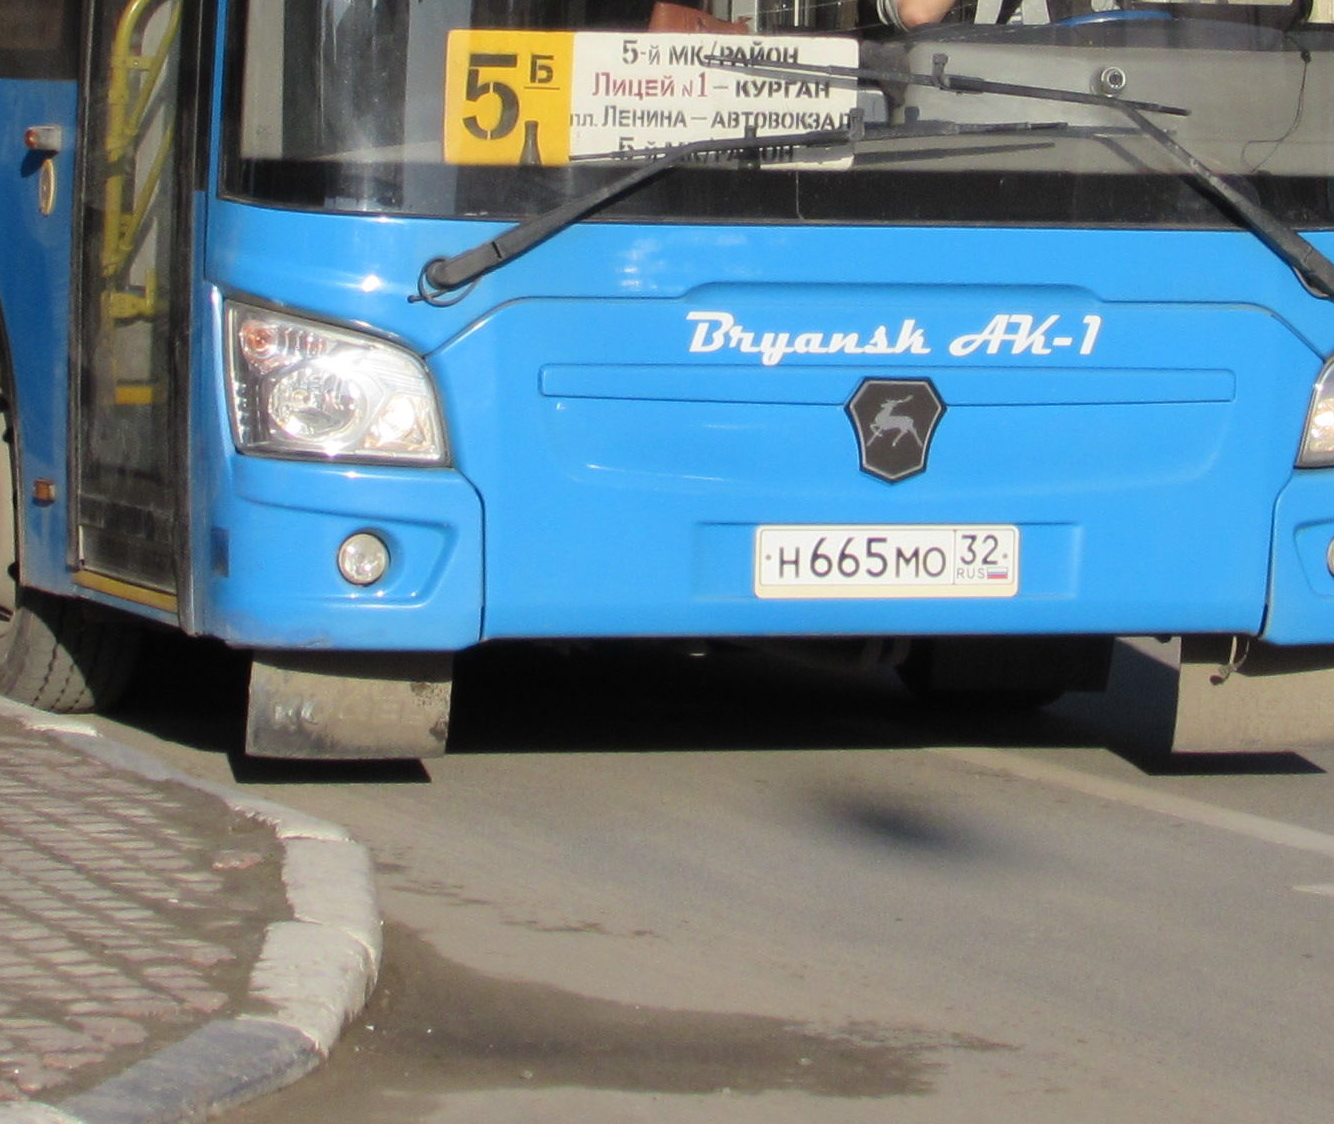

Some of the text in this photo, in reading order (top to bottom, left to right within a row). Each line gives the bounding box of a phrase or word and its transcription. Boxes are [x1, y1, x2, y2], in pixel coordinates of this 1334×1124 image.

[462, 52, 520, 141] 5
[734, 78, 831, 99] КУРГАН
[685, 310, 1103, 367] Bryansk AK-1
[959, 534, 1000, 566] 32
[956, 567, 986, 580] RUS
